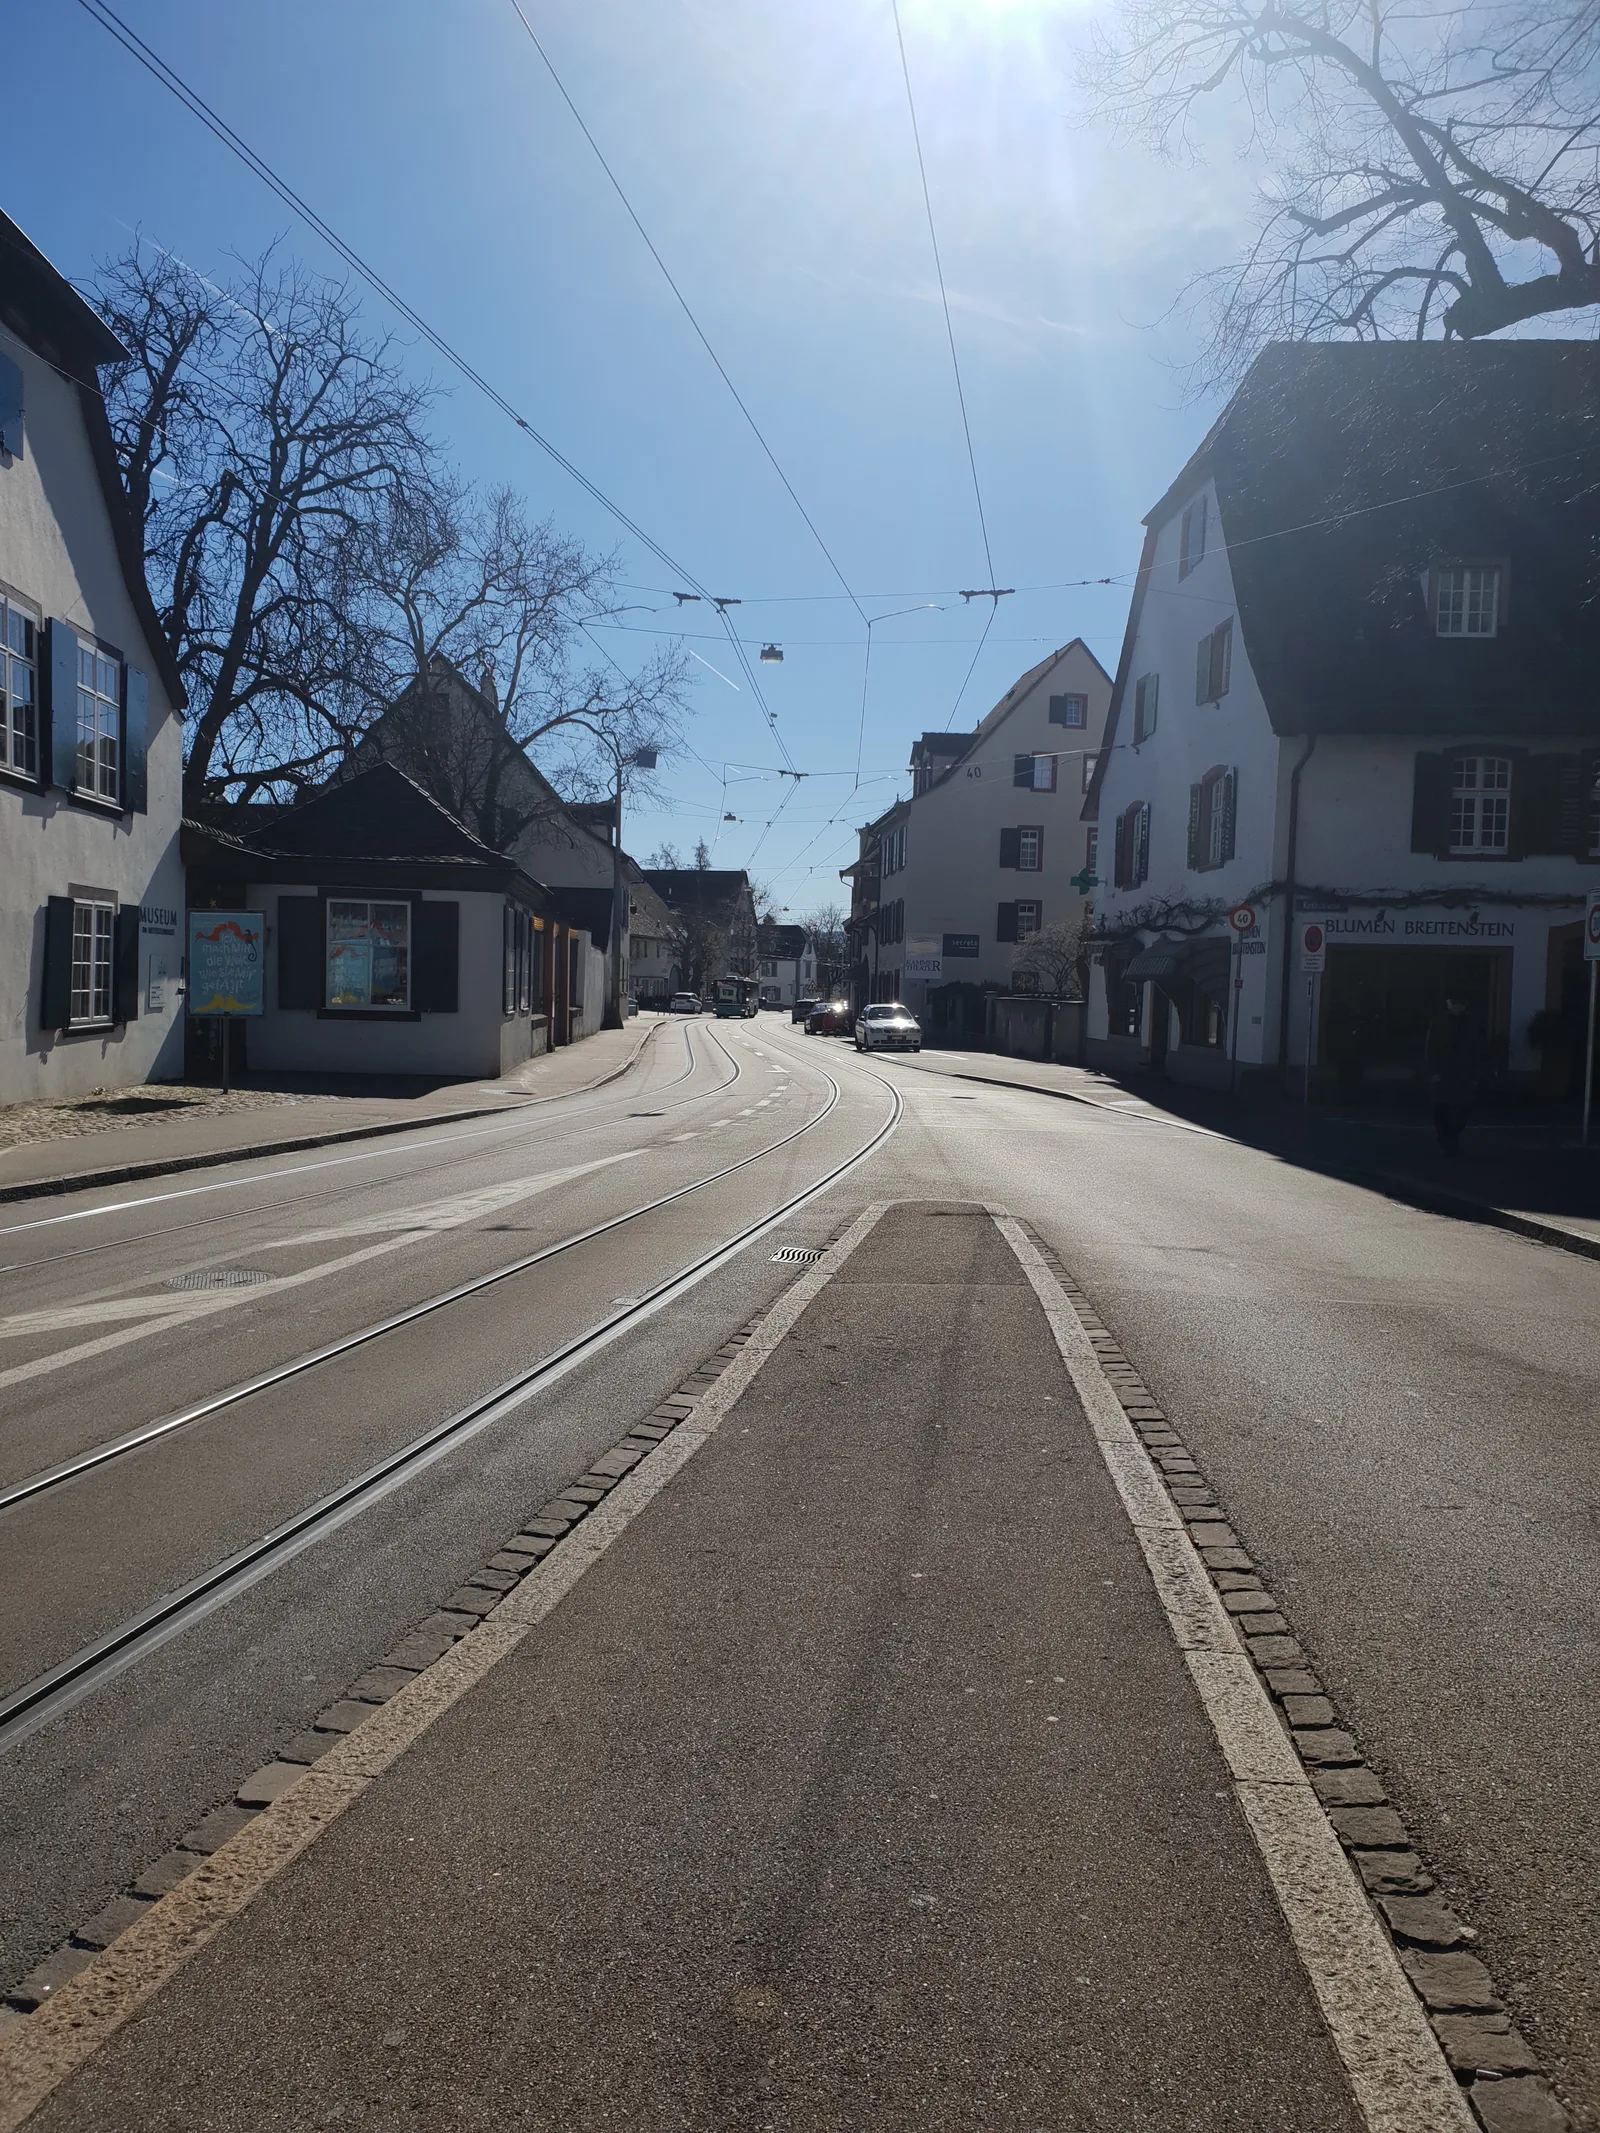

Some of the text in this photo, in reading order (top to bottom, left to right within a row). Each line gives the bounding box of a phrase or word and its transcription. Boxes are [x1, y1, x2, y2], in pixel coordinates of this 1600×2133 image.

[967, 766, 982, 779] 40
[139, 906, 178, 926] MUSEUM
[1237, 913, 1249, 924] 40
[1325, 919, 1516, 937] BLUMEN BREITENSTEIN
[202, 943, 230, 954] mach
[206, 954, 248, 966] die Welt
